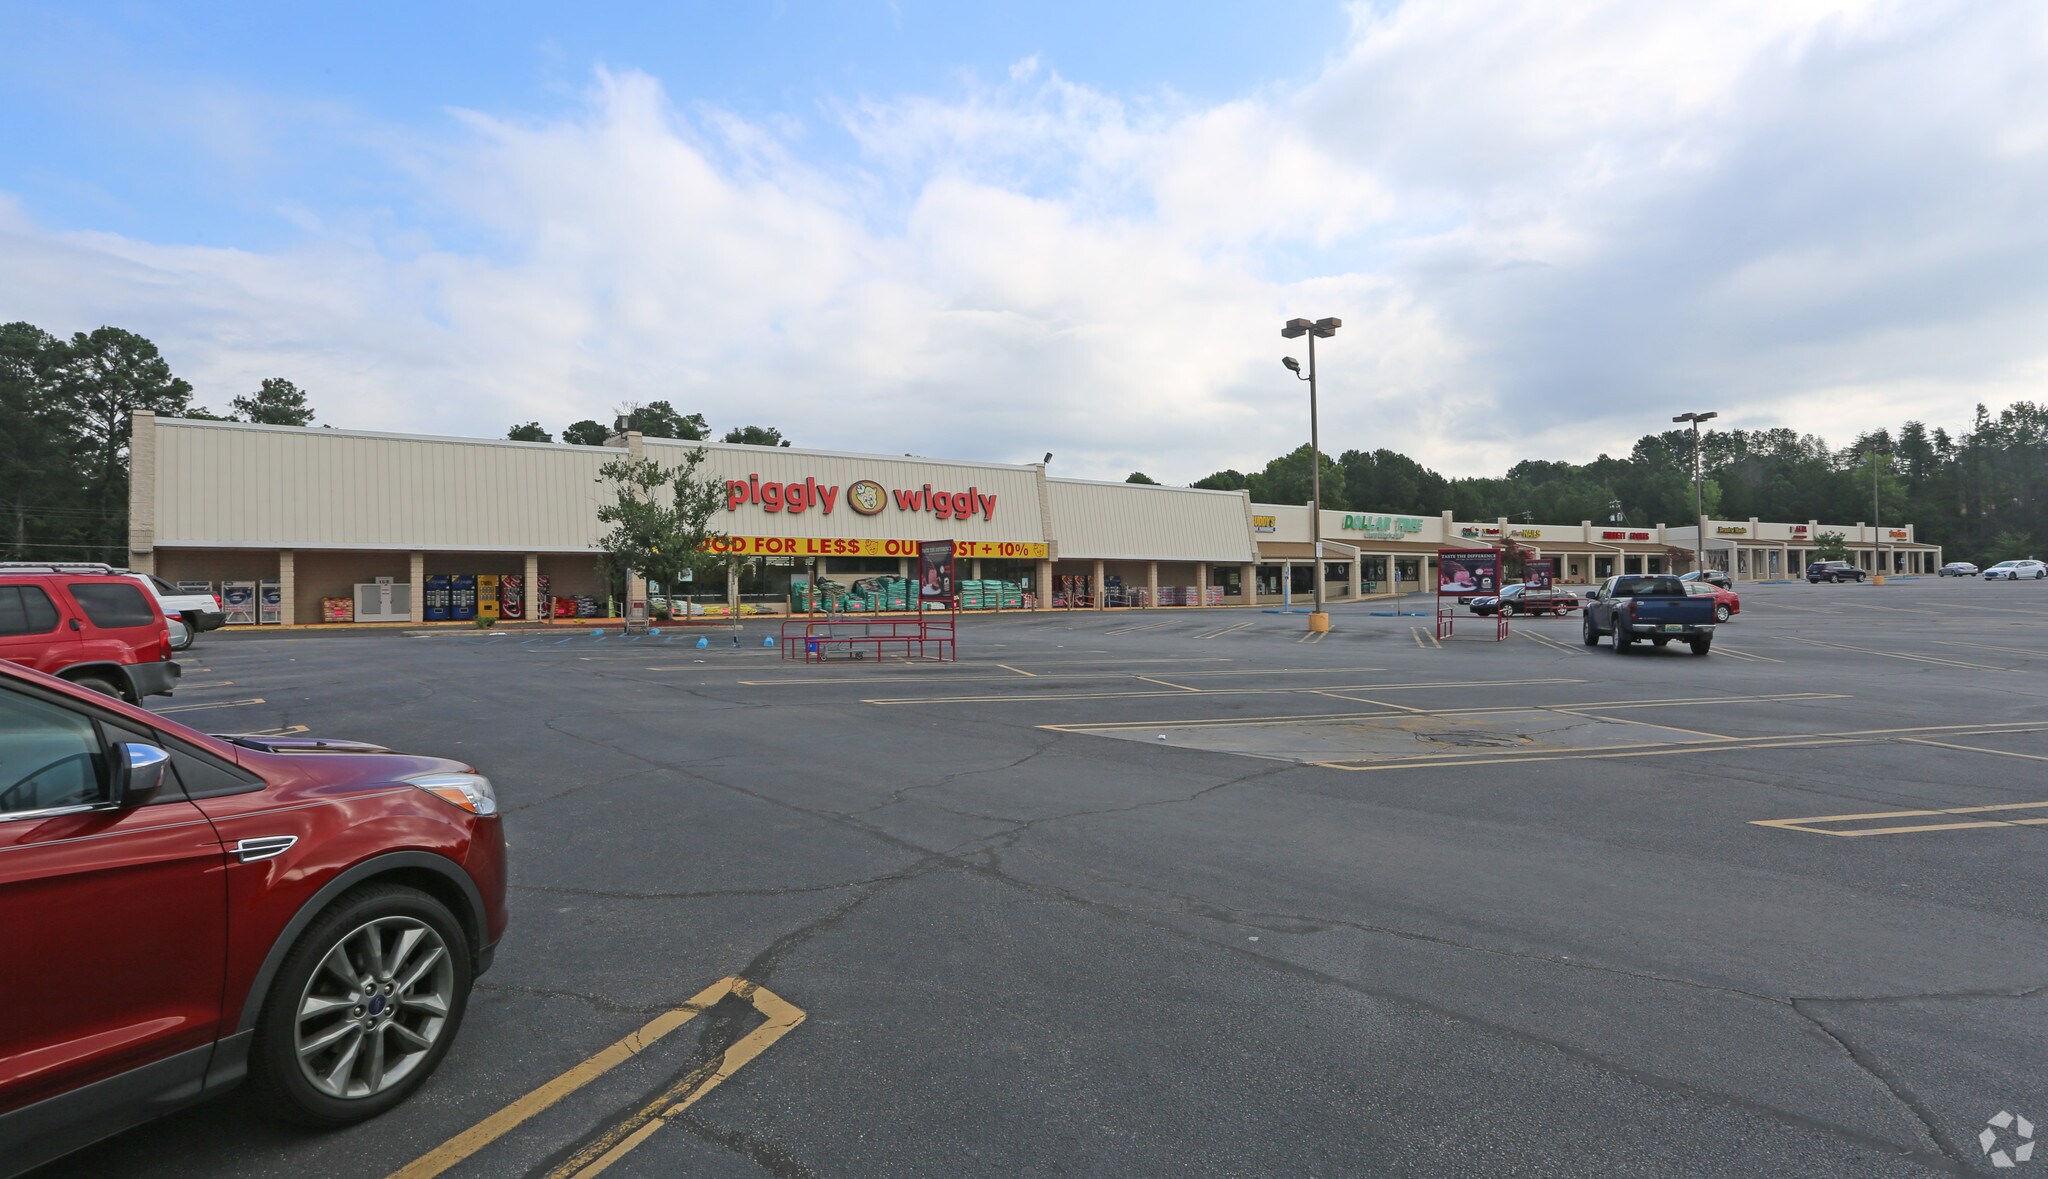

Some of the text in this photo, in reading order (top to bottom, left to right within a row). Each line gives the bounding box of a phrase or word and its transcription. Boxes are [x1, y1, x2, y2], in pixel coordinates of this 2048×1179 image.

[726, 474, 997, 521] piggly wiggly
[1252, 515, 1276, 527] UDDY'S
[1343, 514, 1423, 533] DOLLAR TREE
[697, 536, 747, 553] OD
[754, 537, 797, 554] FOR
[807, 538, 860, 555] LE$$
[884, 539, 919, 556] OU
[952, 541, 977, 557] ST
[981, 543, 992, 555] +
[997, 542, 1029, 557] 10%
